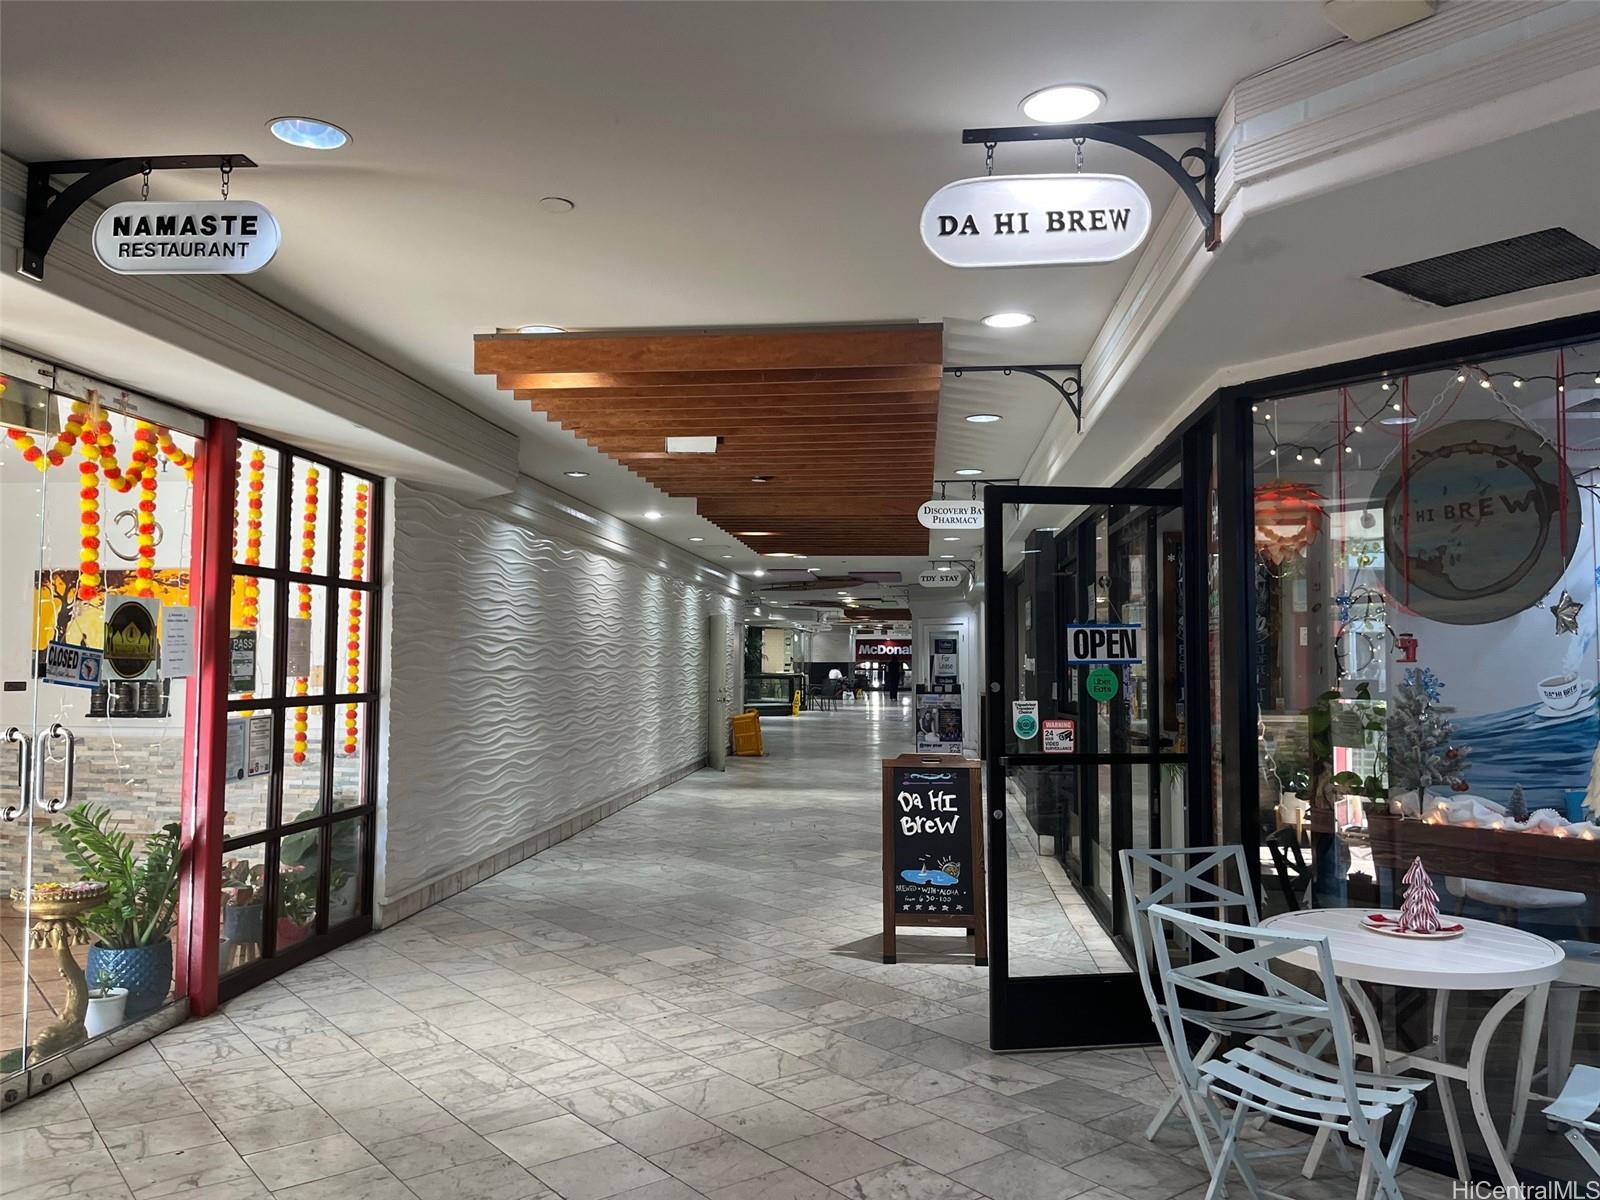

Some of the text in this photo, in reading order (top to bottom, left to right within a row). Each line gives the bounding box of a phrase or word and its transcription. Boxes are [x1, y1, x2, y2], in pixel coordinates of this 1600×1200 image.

[112, 215, 258, 237] NAMASTE
[938, 208, 1131, 236] DA HI BREW
[118, 242, 249, 258] RESTAURANT
[924, 506, 985, 515] DISCOVERY BA
[932, 516, 978, 524] PHARMACY
[1073, 629, 1137, 659] OPEN
[48, 646, 79, 669] CLOSED
[938, 662, 953, 670] Lease
